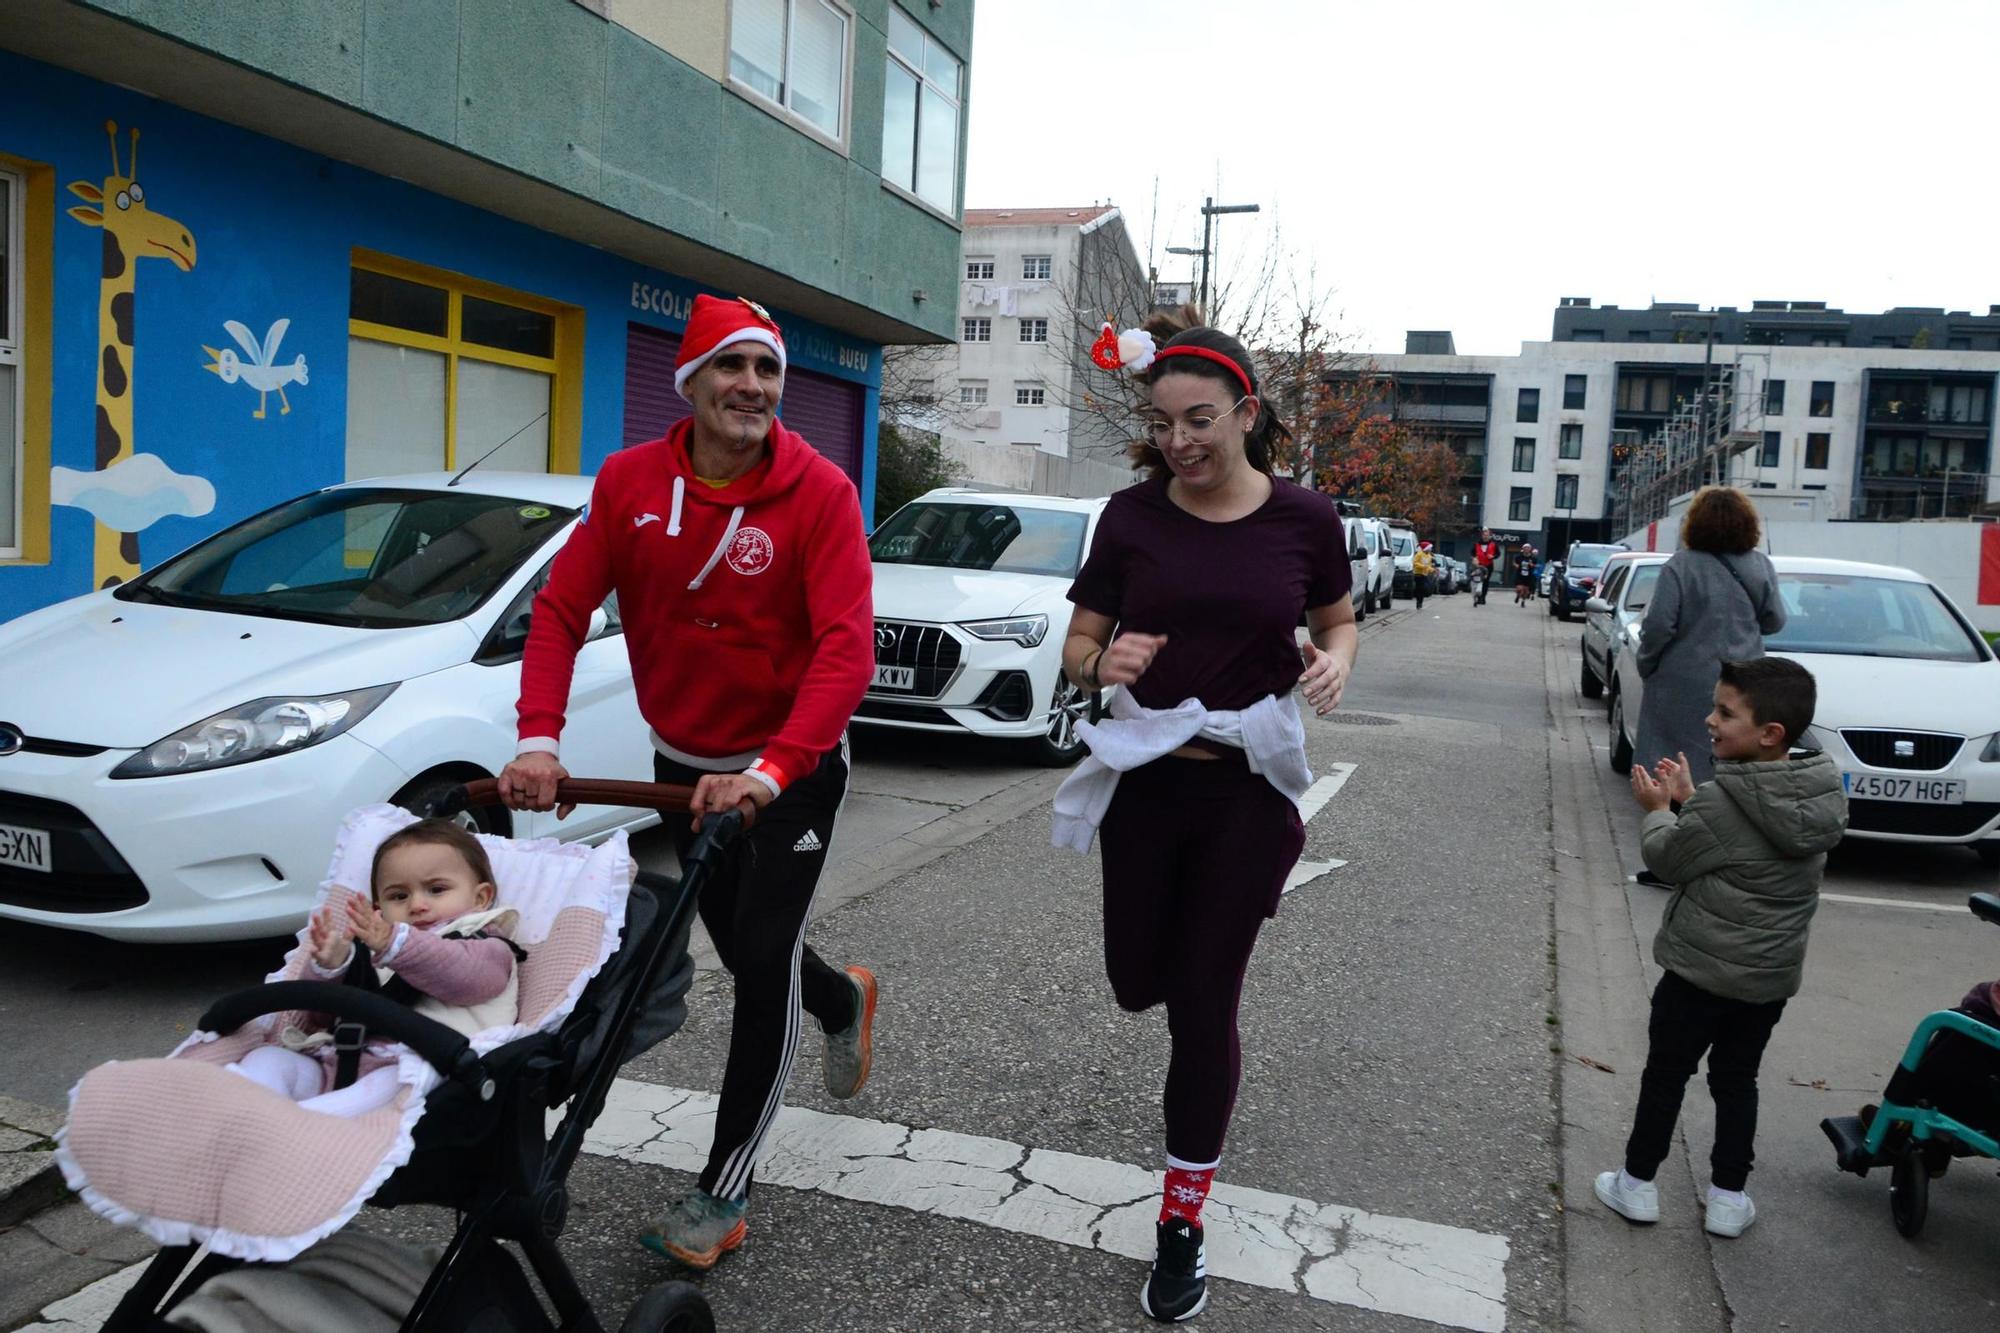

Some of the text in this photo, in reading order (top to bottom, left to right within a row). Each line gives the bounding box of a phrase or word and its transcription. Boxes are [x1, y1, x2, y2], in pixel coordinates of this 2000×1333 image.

[631, 281, 692, 321] ESCOLA
[805, 335, 835, 363] AZUL
[839, 346, 868, 373] BUEU
[878, 668, 910, 685] KWV
[1854, 776, 1957, 801] 4507 HGF
[0, 828, 43, 866] GXN
[793, 842, 822, 852] adidas
